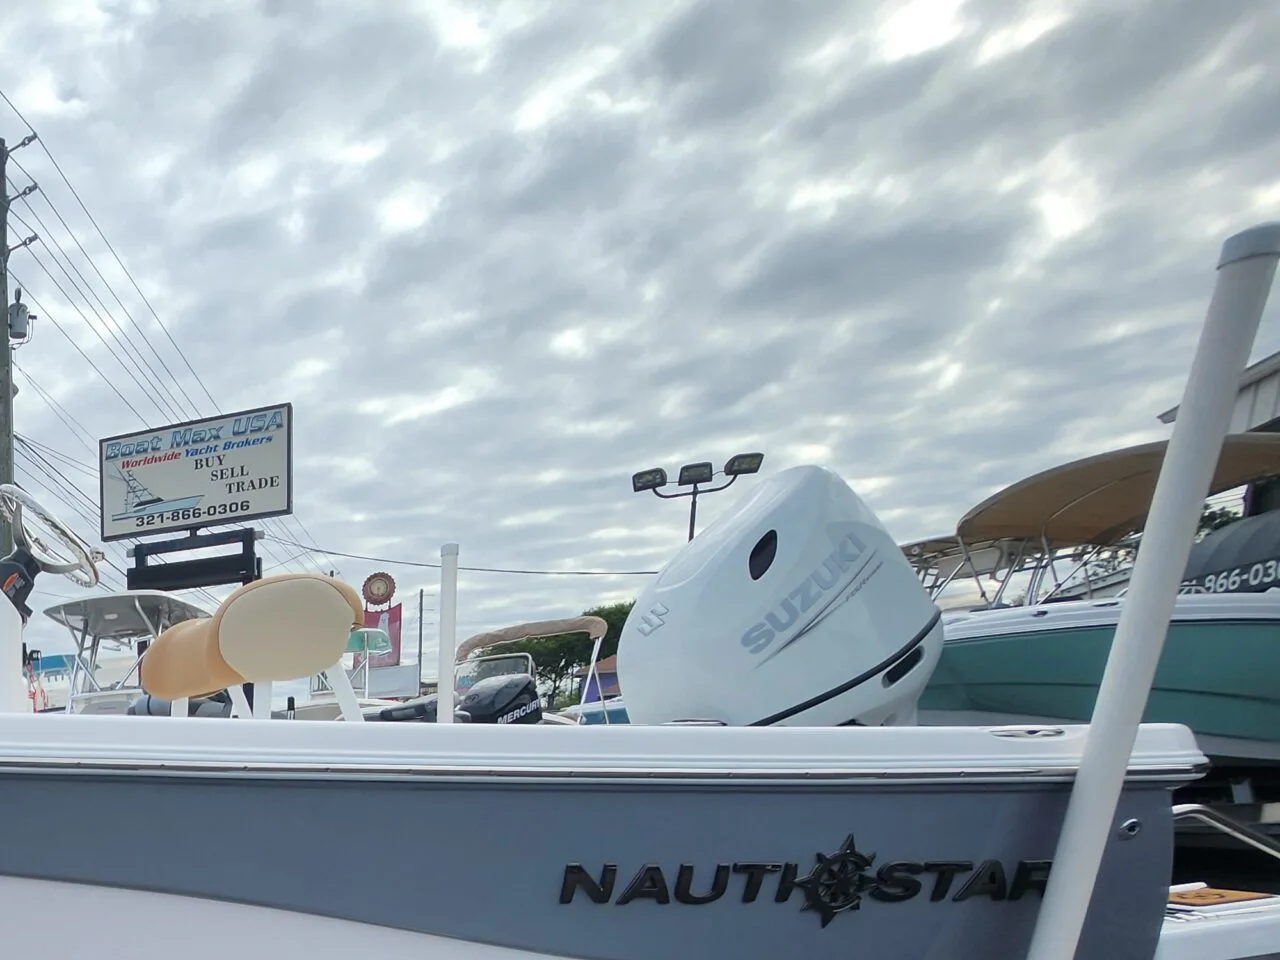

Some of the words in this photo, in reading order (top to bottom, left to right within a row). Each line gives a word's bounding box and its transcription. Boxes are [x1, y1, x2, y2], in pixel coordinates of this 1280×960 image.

[105, 436, 162, 461] Boat
[170, 426, 224, 449] Max
[232, 410, 284, 437] USA
[121, 451, 182, 470] Worldwide
[184, 444, 219, 458] Yacht
[222, 434, 273, 451] Brokers
[194, 454, 226, 470] BUY
[210, 465, 249, 482] SELL
[226, 476, 280, 494] TRADE
[136, 500, 250, 527] 321-866-0306
[740, 532, 867, 655] SUZUKI
